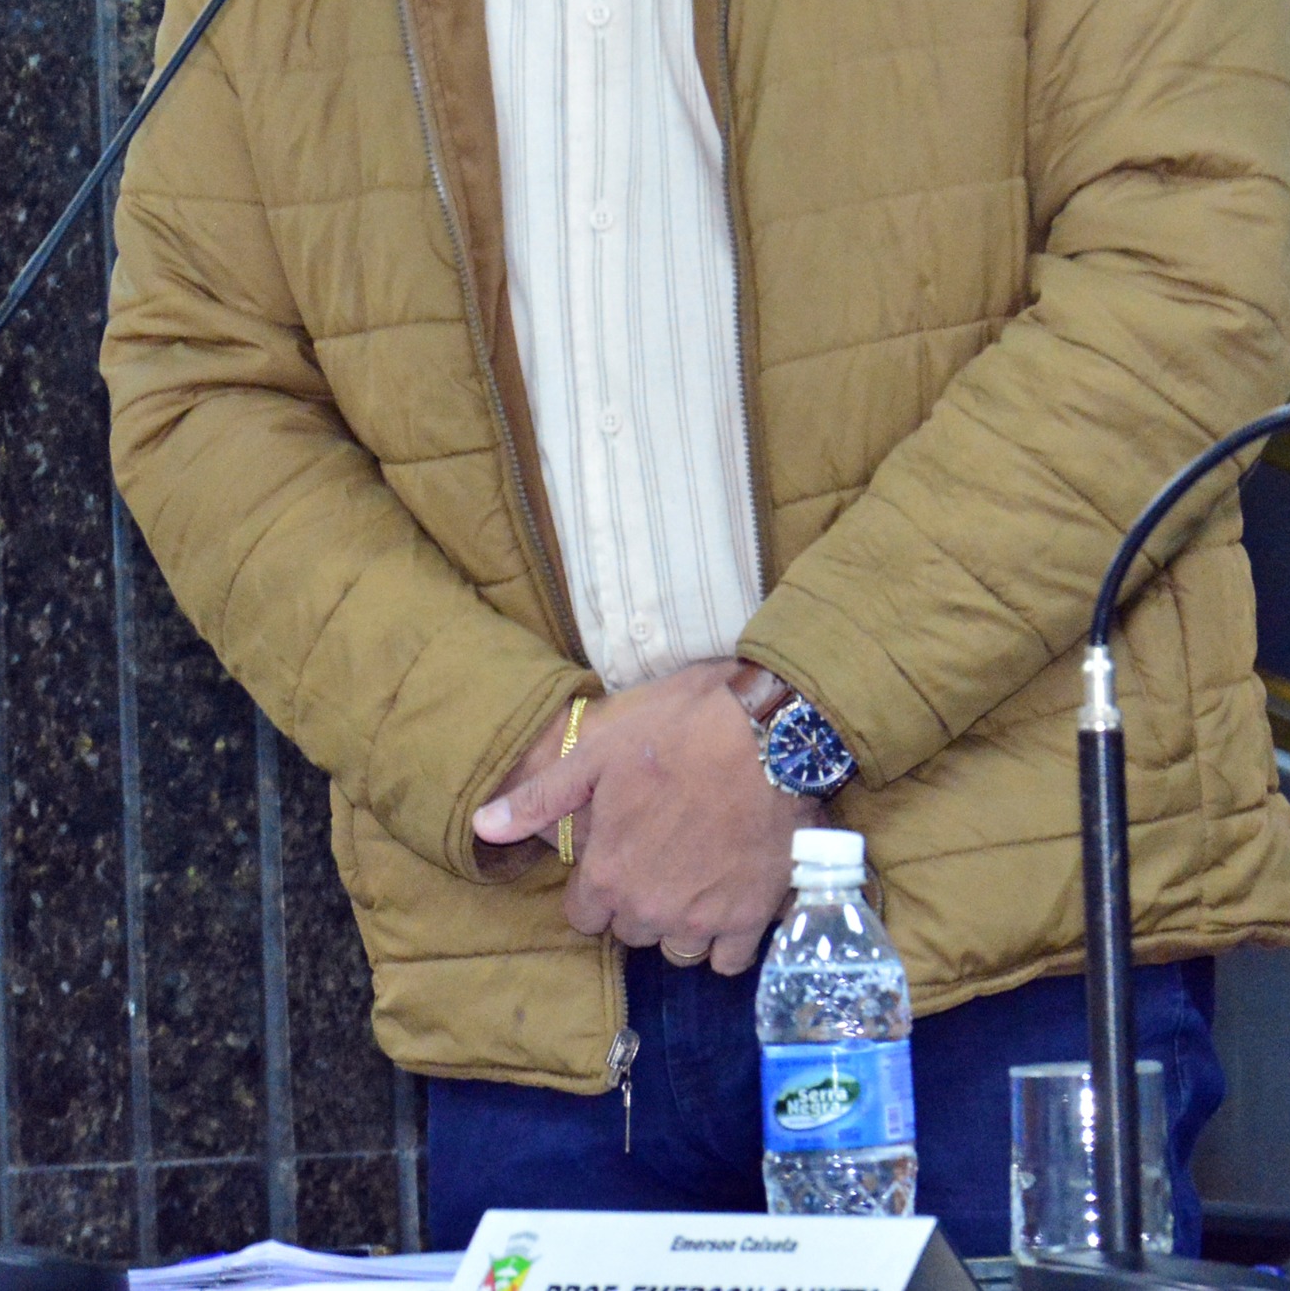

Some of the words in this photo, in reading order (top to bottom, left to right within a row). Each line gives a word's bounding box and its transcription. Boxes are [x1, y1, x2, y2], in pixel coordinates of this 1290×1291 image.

[798, 1086, 849, 1103] Serra
[787, 1099, 841, 1119] Negra
[670, 1235, 737, 1252] Emerson
[740, 1235, 798, 1253] Caixeta
